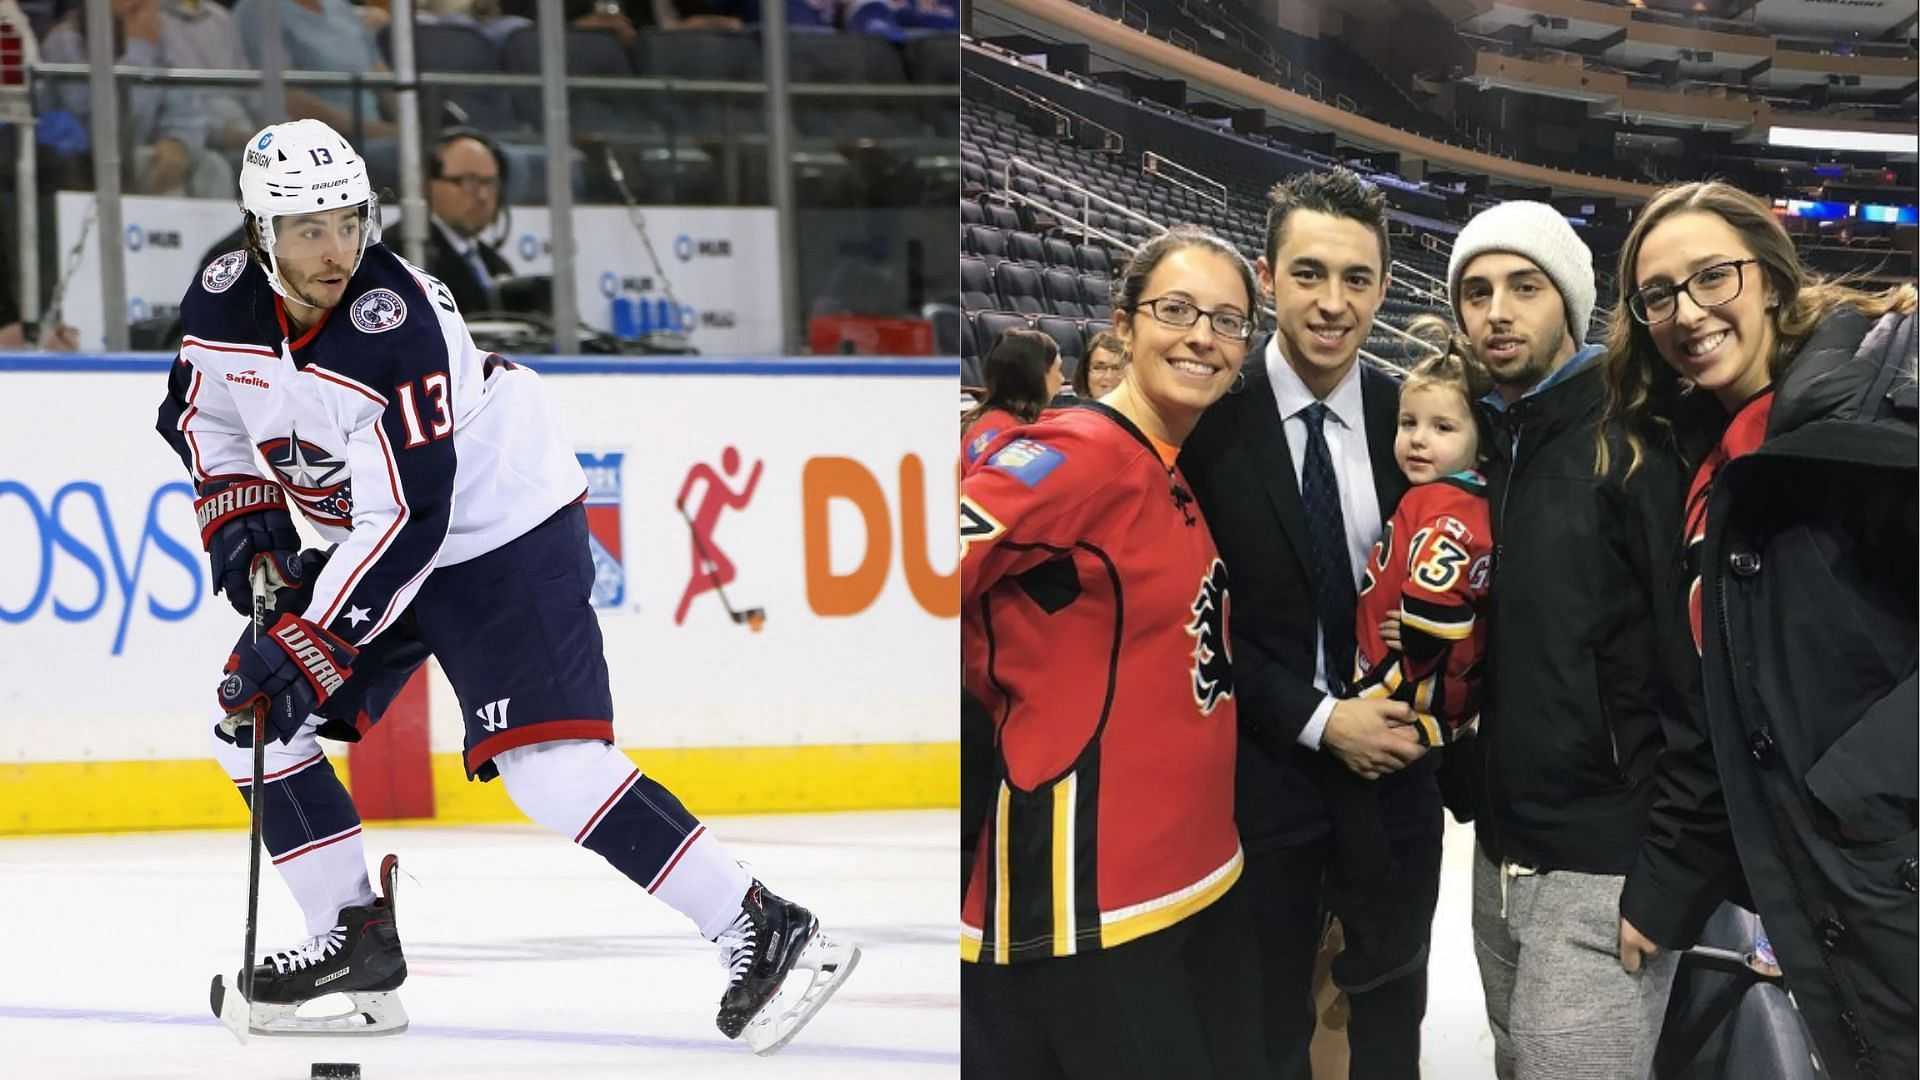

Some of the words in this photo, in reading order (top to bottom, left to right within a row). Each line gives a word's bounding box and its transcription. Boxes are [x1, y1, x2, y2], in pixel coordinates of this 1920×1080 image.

[308, 147, 334, 167] 13
[311, 178, 349, 190] BAUER
[225, 373, 270, 389] Safelite
[395, 371, 453, 448] 13
[0, 480, 204, 656] osys
[1407, 526, 1471, 593] 13
